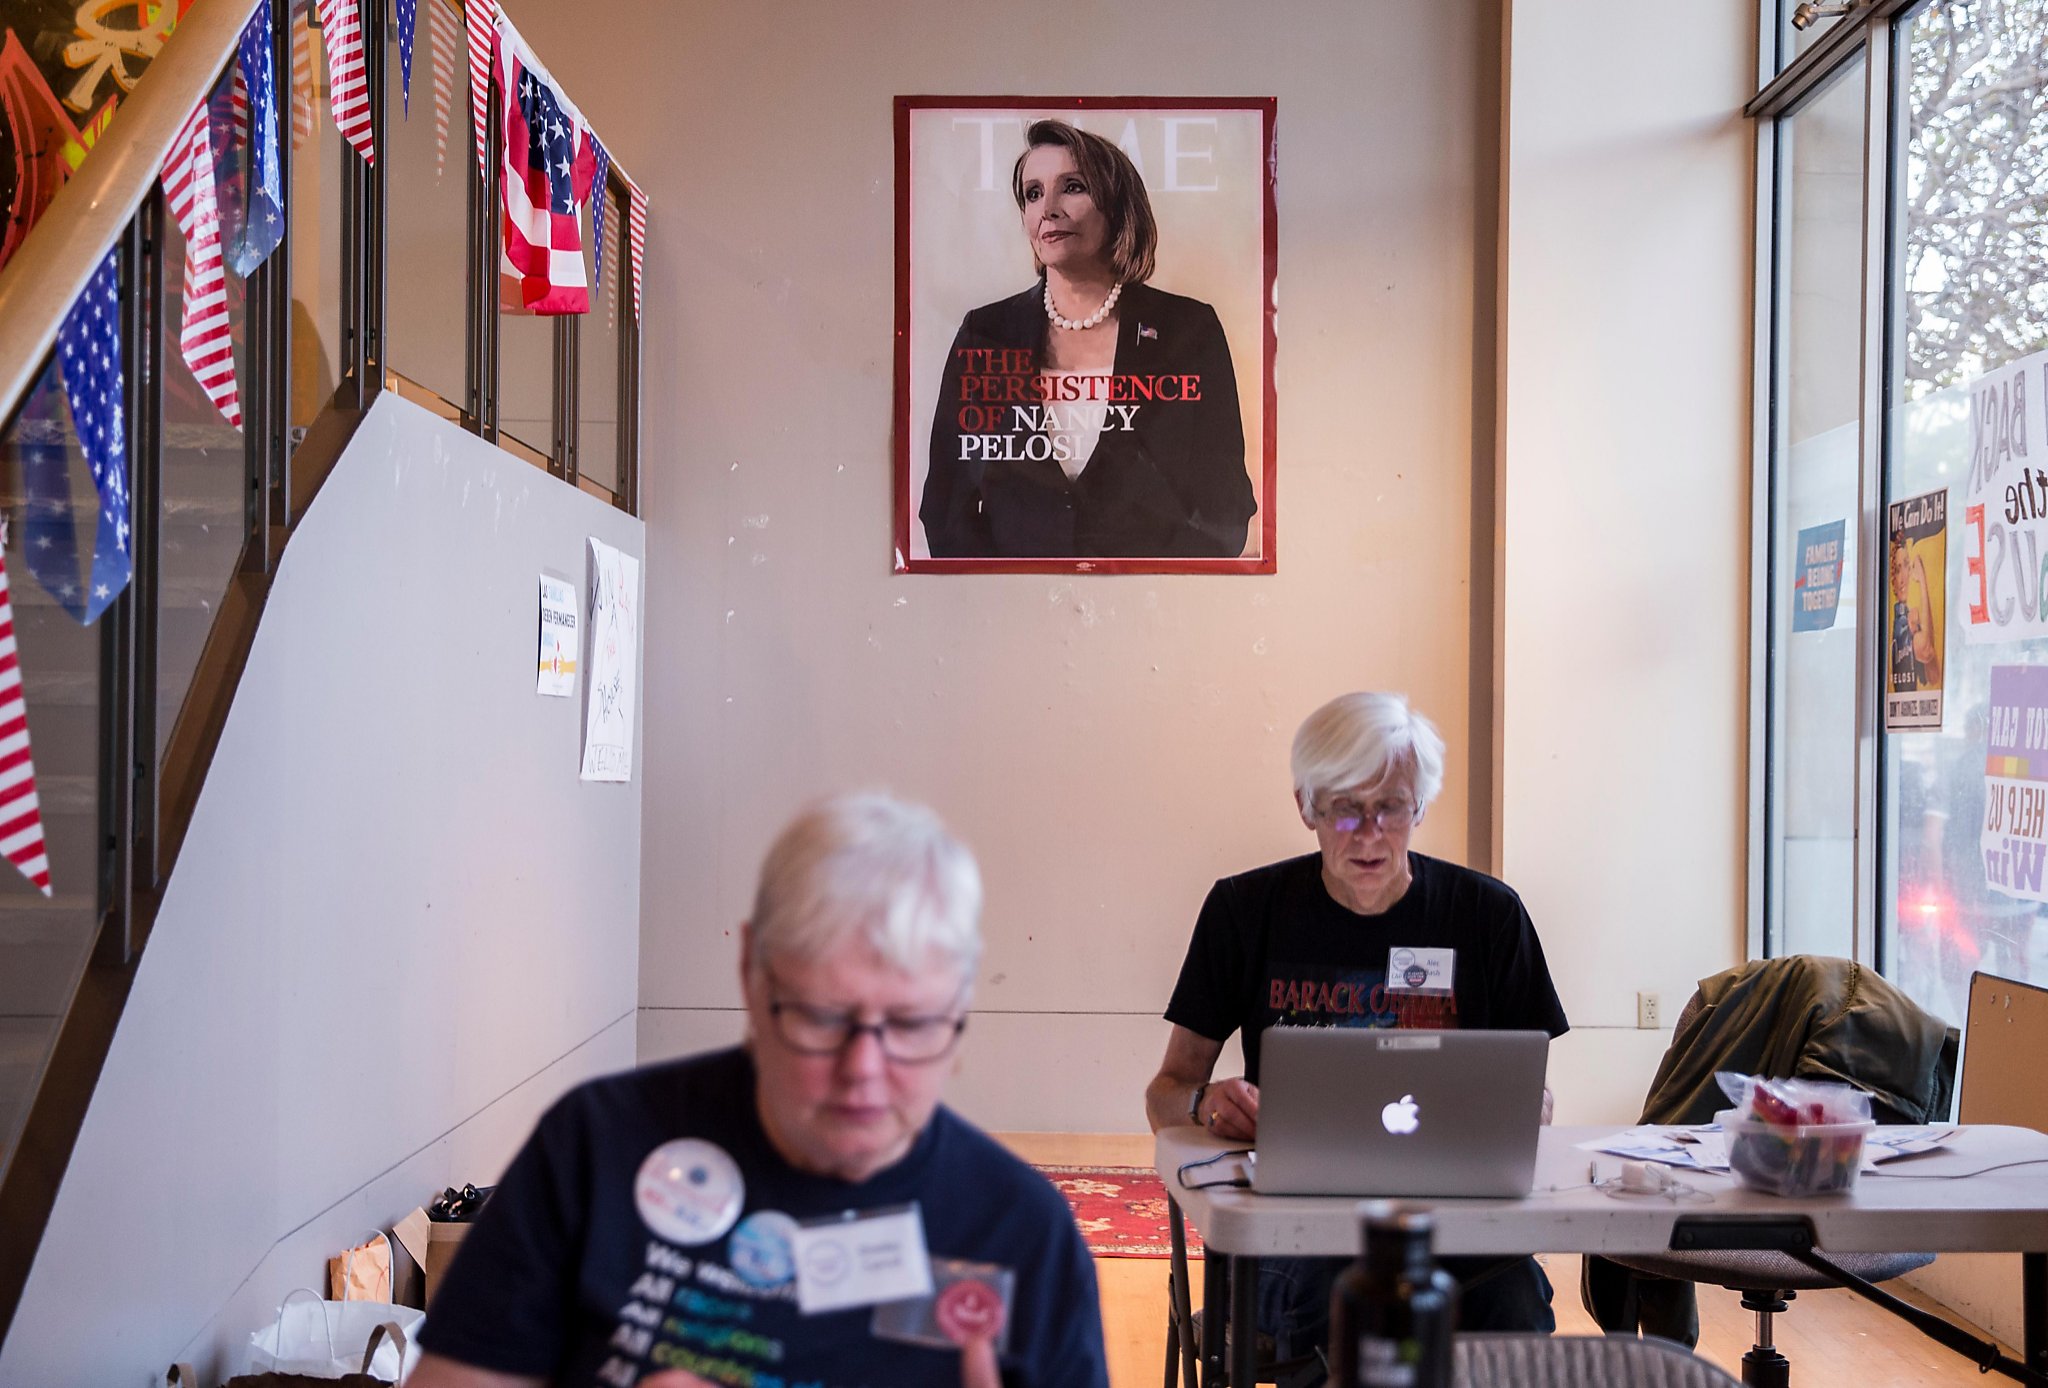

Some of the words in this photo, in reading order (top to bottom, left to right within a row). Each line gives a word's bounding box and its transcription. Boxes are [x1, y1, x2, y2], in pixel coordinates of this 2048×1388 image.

[952, 117, 1218, 192] TME
[957, 348, 1034, 375] THE
[959, 374, 1202, 401] PERSISTENCE
[957, 405, 1006, 433] OF
[1011, 405, 1141, 432] NANCY
[957, 434, 1085, 461] PELOSI
[1891, 505, 1904, 532] We
[1903, 502, 1920, 529] Can
[1920, 498, 1933, 525] Do
[1269, 979, 1366, 1015] BARACK
